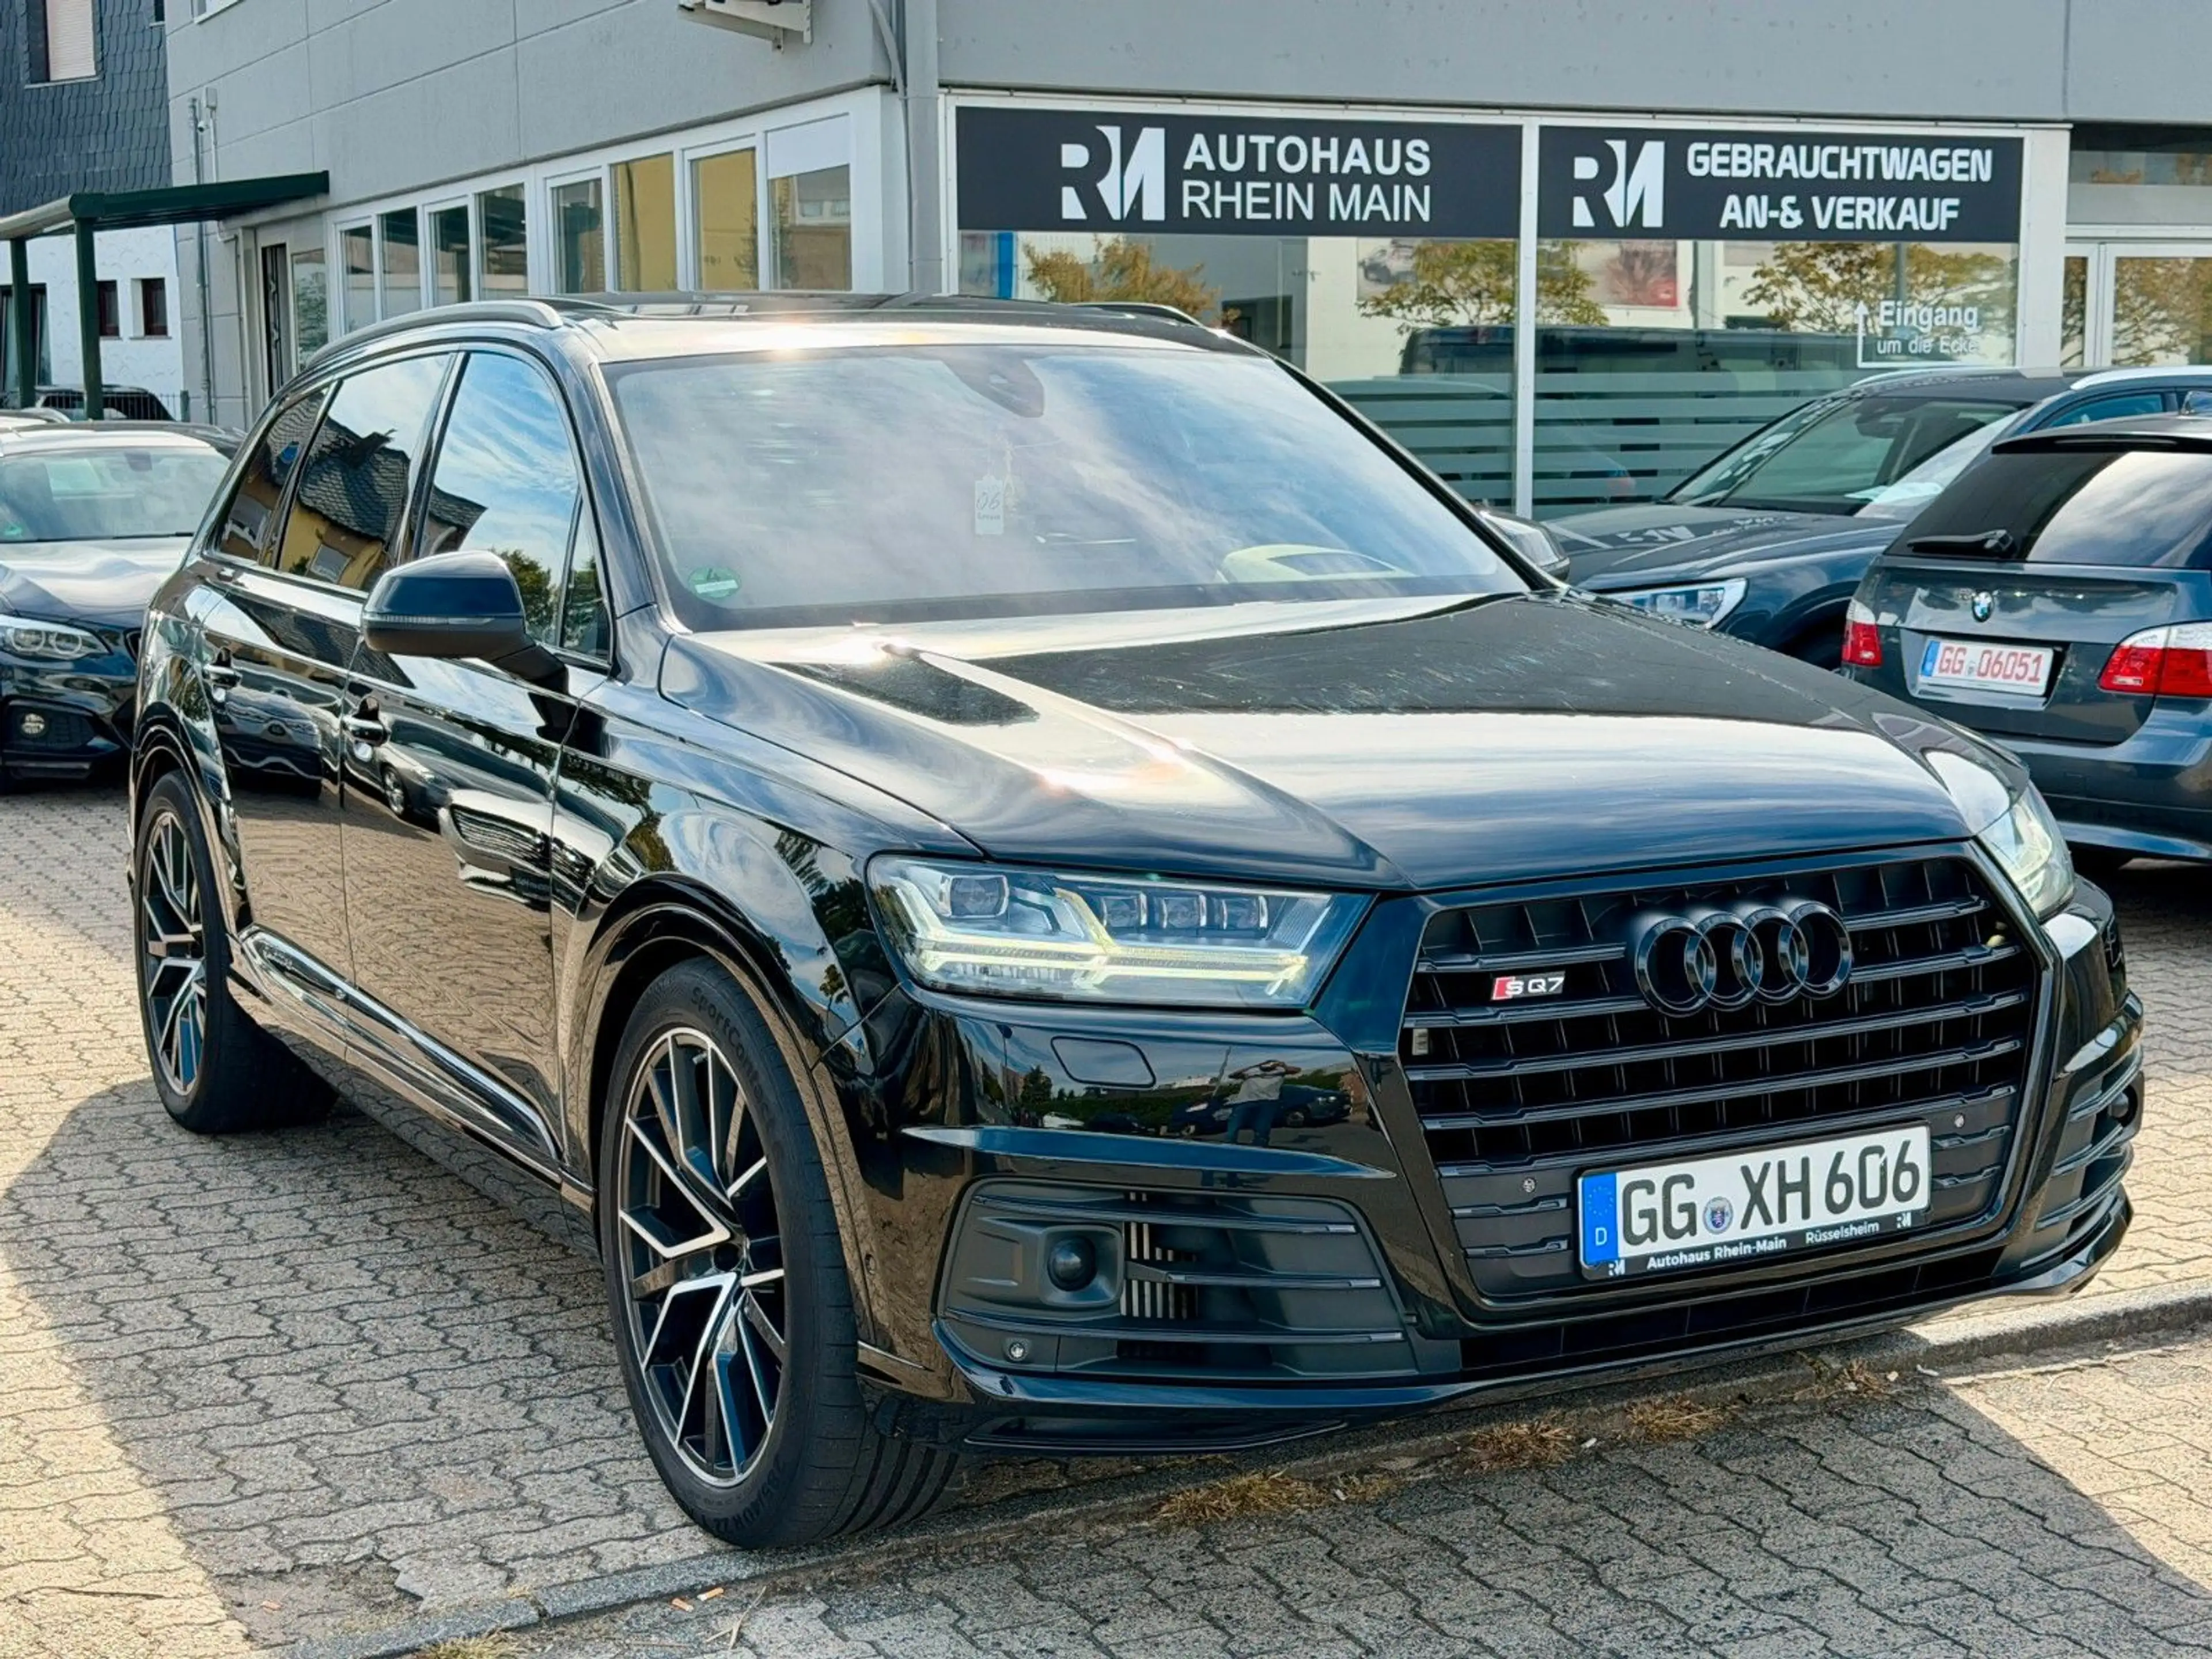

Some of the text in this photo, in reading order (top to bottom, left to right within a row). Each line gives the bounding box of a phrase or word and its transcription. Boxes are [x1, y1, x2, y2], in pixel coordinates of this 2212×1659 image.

[1061, 126, 1165, 221] RM
[1183, 133, 1430, 176] AUTOHAUS
[1687, 142, 1992, 182] GEBRAUCHTWAGEN
[1183, 180, 1430, 222] RHEIN MAIN
[1573, 139, 1665, 228] RM
[1719, 194, 1960, 230] AN-& VERKAUF
[1880, 300, 1979, 333] Eingang
[1877, 335, 1978, 354] um die Ecke
[1938, 646, 2042, 683] GG 06051
[1622, 1140, 1920, 1246] GG XH 606
[1595, 1227, 1607, 1246] D
[1646, 1250, 1711, 1270] Autohaus
[1714, 1236, 1787, 1259] Rhein-Main
[1805, 1221, 1880, 1244] Rüsselsheim
